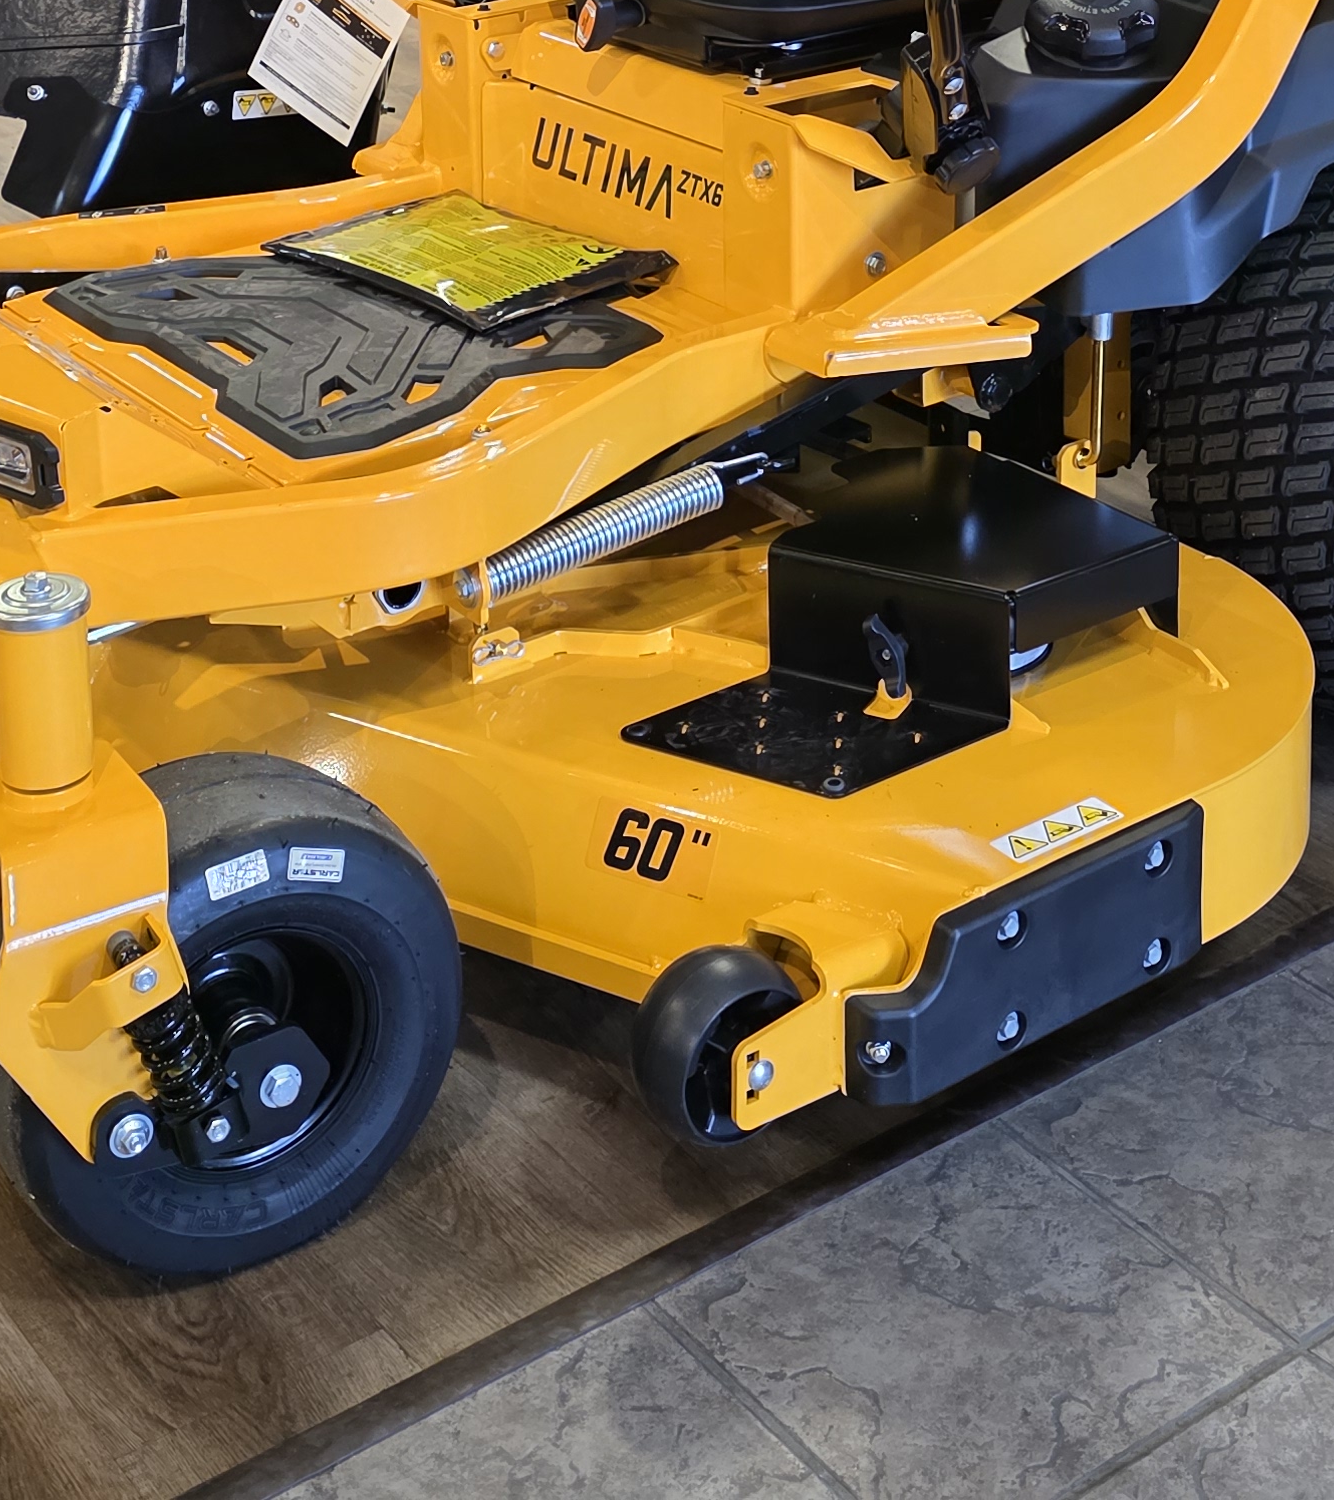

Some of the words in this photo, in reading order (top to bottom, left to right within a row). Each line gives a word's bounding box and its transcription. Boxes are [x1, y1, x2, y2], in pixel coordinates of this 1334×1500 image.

[532, 117, 673, 219] ULTIMA
[676, 169, 725, 209] ZTX6
[602, 806, 713, 884] 60"
